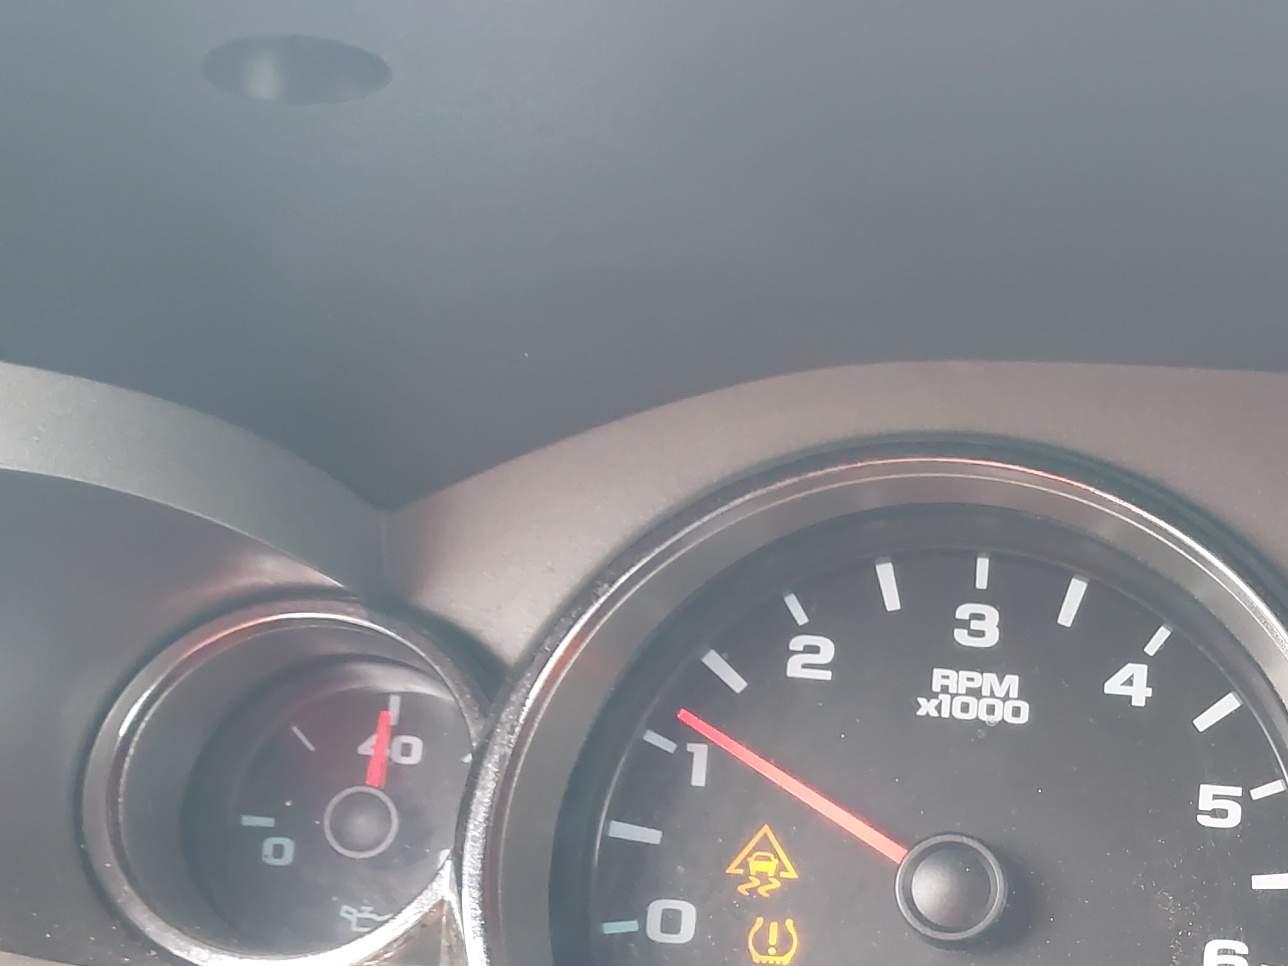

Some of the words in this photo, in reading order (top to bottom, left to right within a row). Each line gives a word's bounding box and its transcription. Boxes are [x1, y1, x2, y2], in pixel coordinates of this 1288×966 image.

[954, 604, 1000, 648] 3
[786, 636, 835, 681] 2
[931, 668, 1020, 696] RPM
[1103, 663, 1153, 706] 4
[916, 695, 1030, 725] x1000
[686, 743, 708, 787] 1
[1196, 784, 1243, 829] 5
[261, 836, 296, 867] 0
[646, 899, 697, 945] 0
